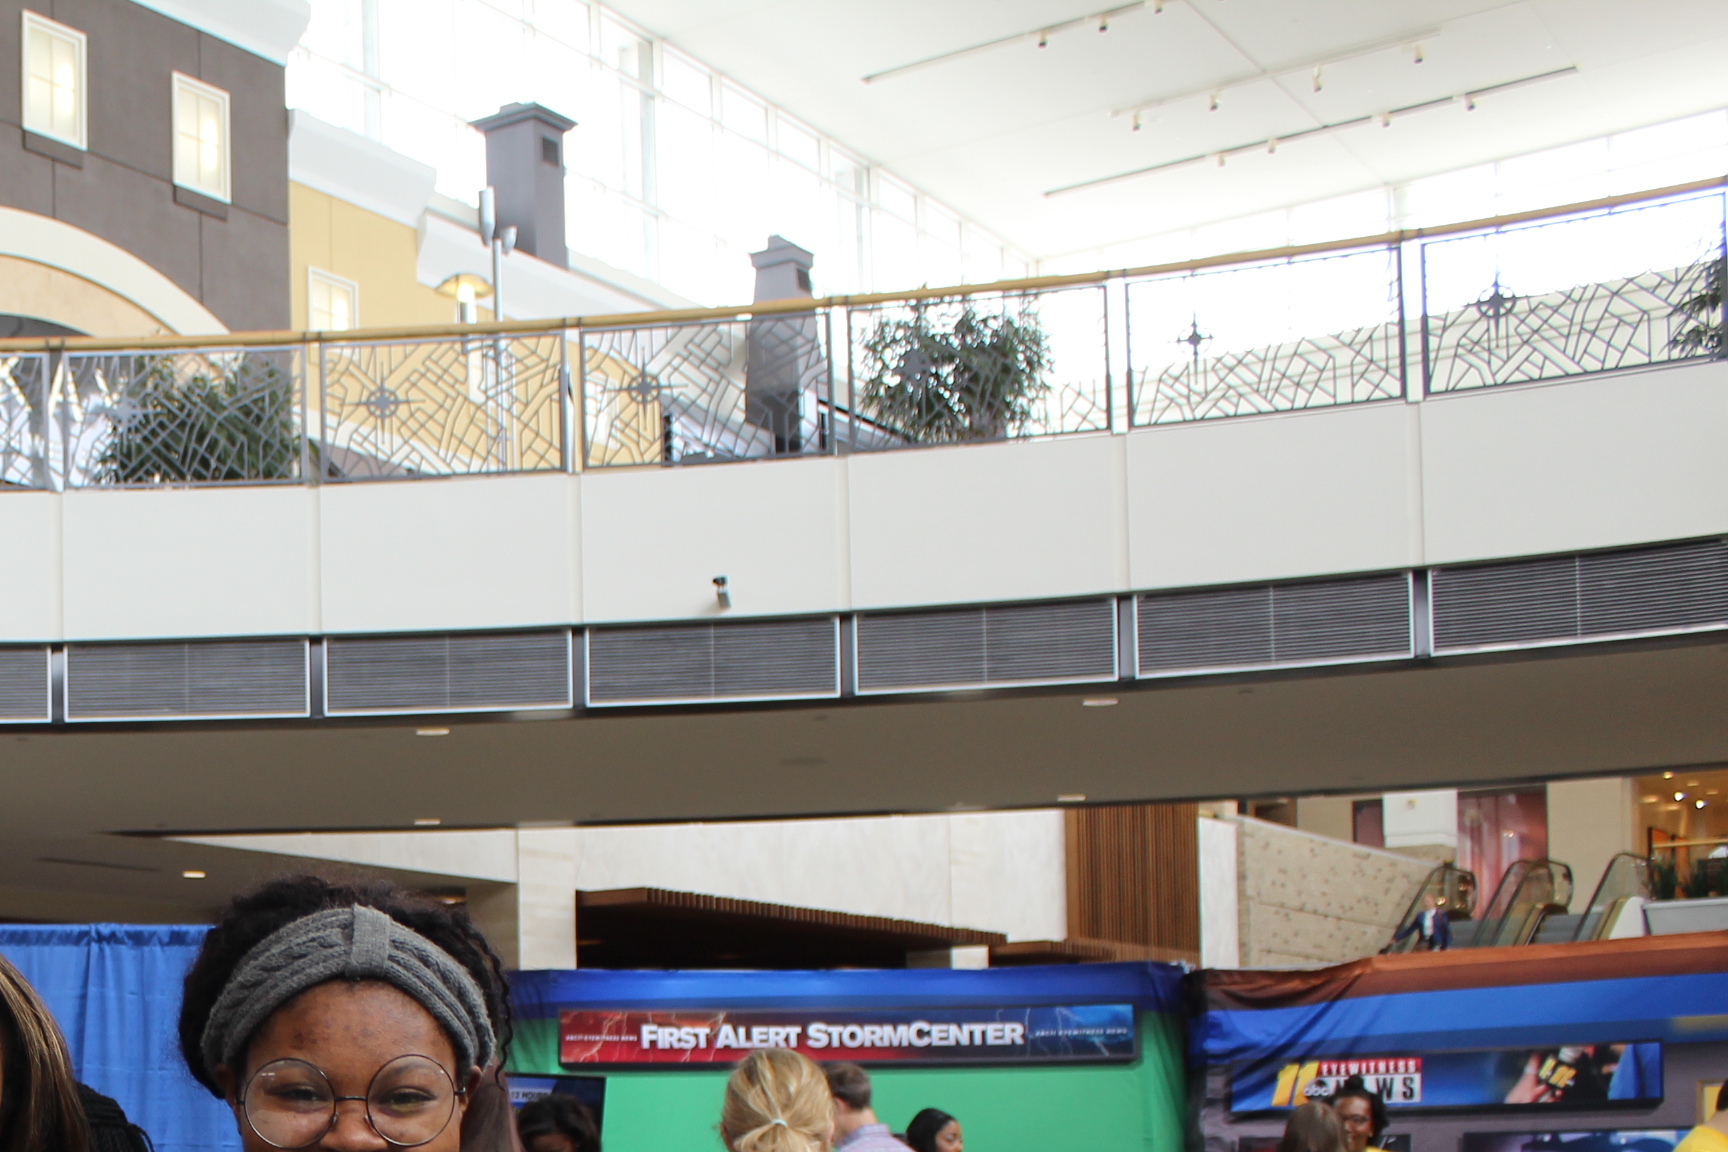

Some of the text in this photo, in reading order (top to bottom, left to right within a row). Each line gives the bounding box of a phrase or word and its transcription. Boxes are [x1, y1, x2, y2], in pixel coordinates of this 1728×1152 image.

[1322, 1059, 1416, 1075] EYEWITNESS
[1272, 1061, 1320, 1106] 11
[1304, 1078, 1332, 1097] abc
